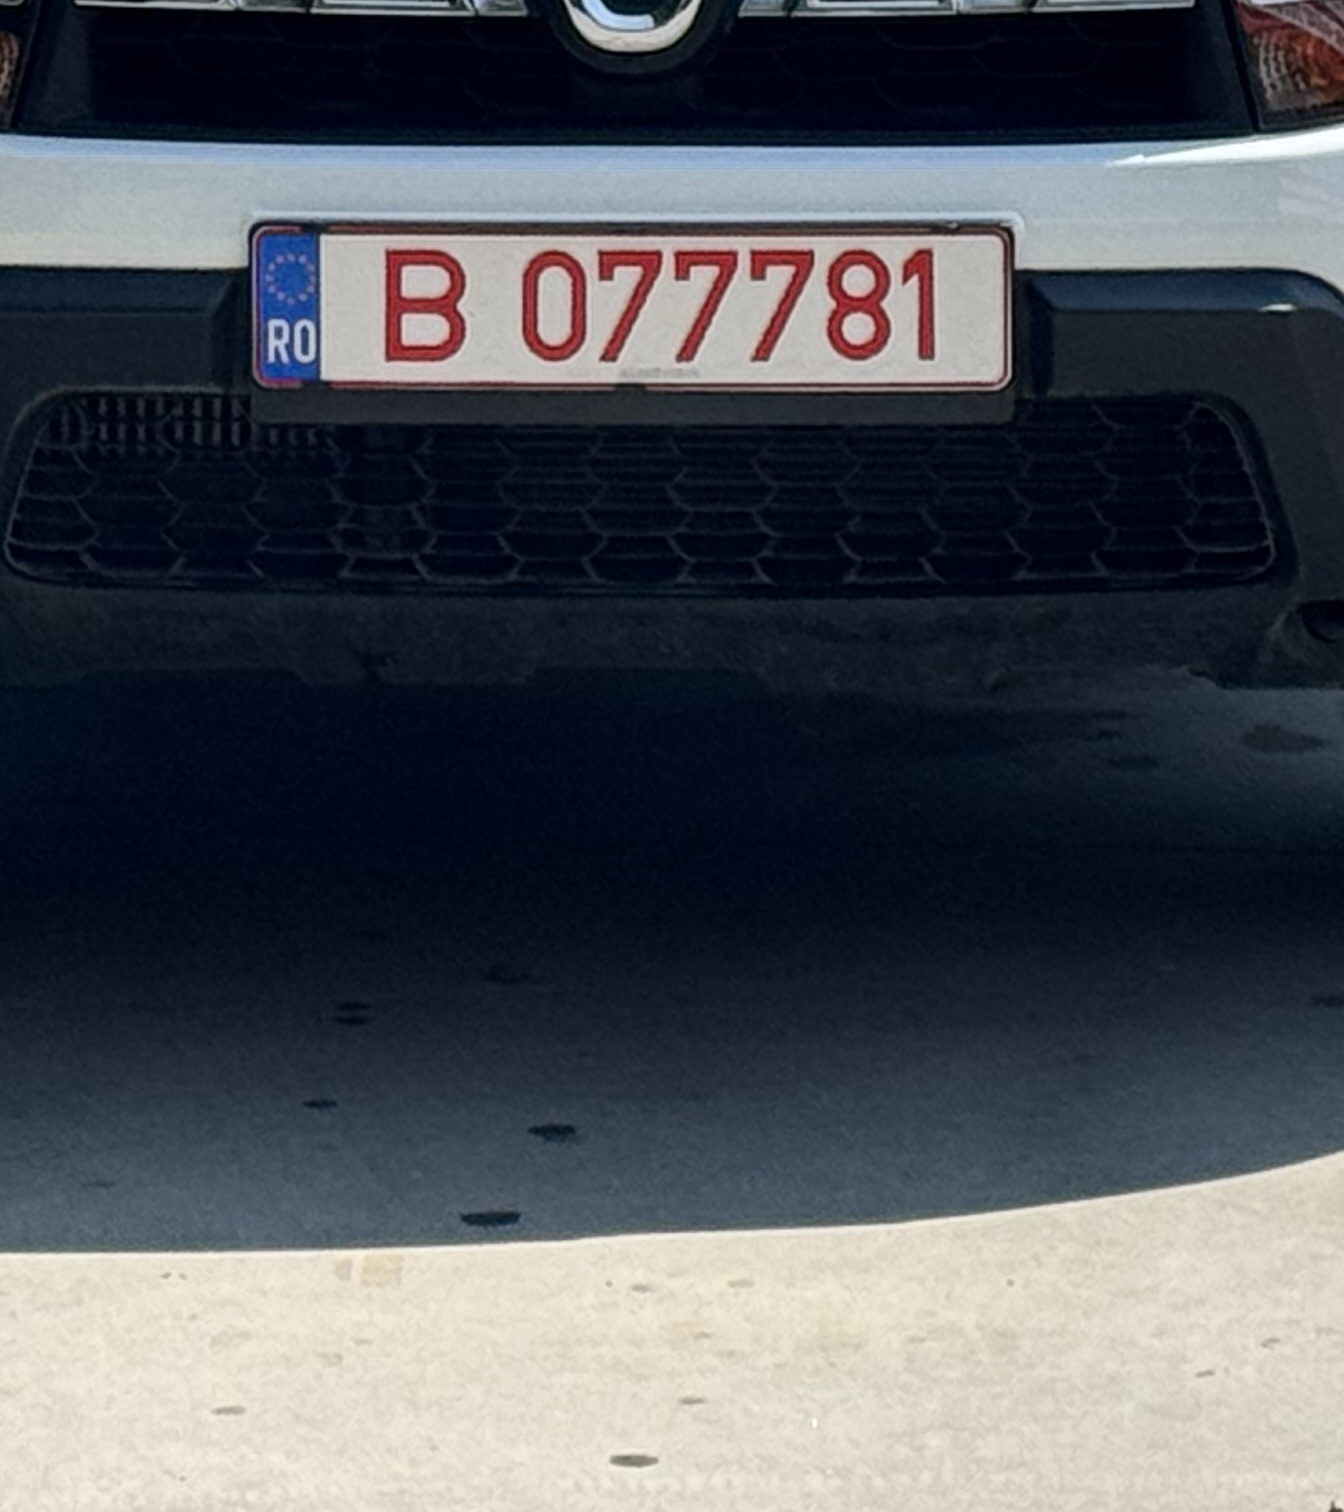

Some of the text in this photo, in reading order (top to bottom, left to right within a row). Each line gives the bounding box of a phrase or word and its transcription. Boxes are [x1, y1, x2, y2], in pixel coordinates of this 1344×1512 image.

[267, 319, 316, 364] RO
[385, 248, 936, 362] B 077781
